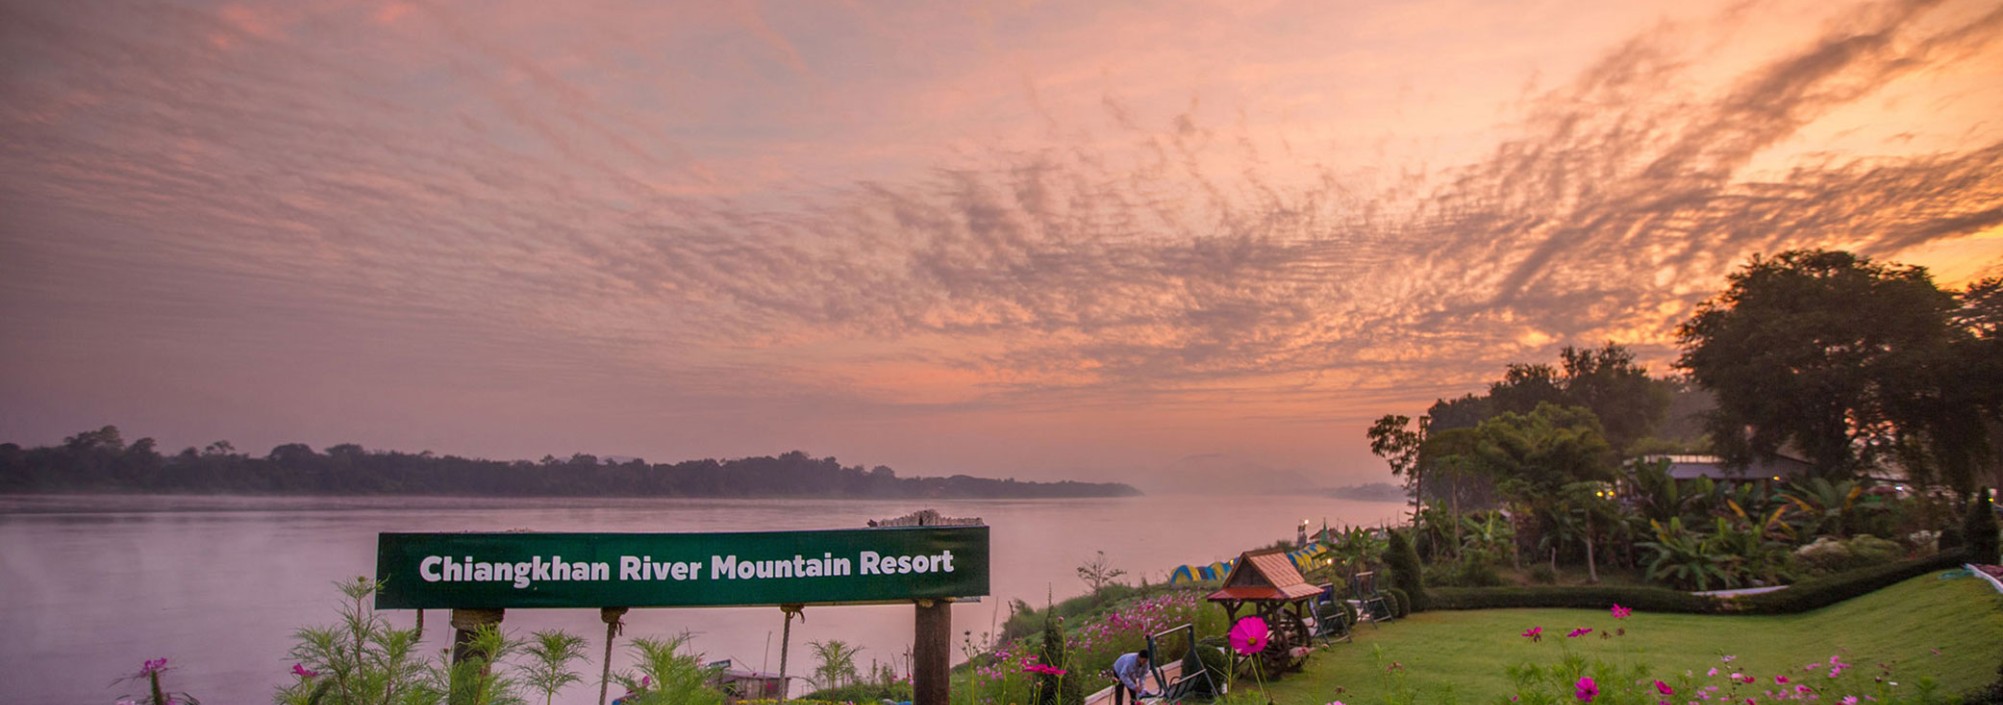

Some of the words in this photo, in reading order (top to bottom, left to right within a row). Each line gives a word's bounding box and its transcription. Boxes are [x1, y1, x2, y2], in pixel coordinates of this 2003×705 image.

[420, 555, 610, 589] Chiangkhan
[619, 554, 702, 581] River
[711, 552, 851, 580] Mountain
[860, 550, 955, 575] Resort
